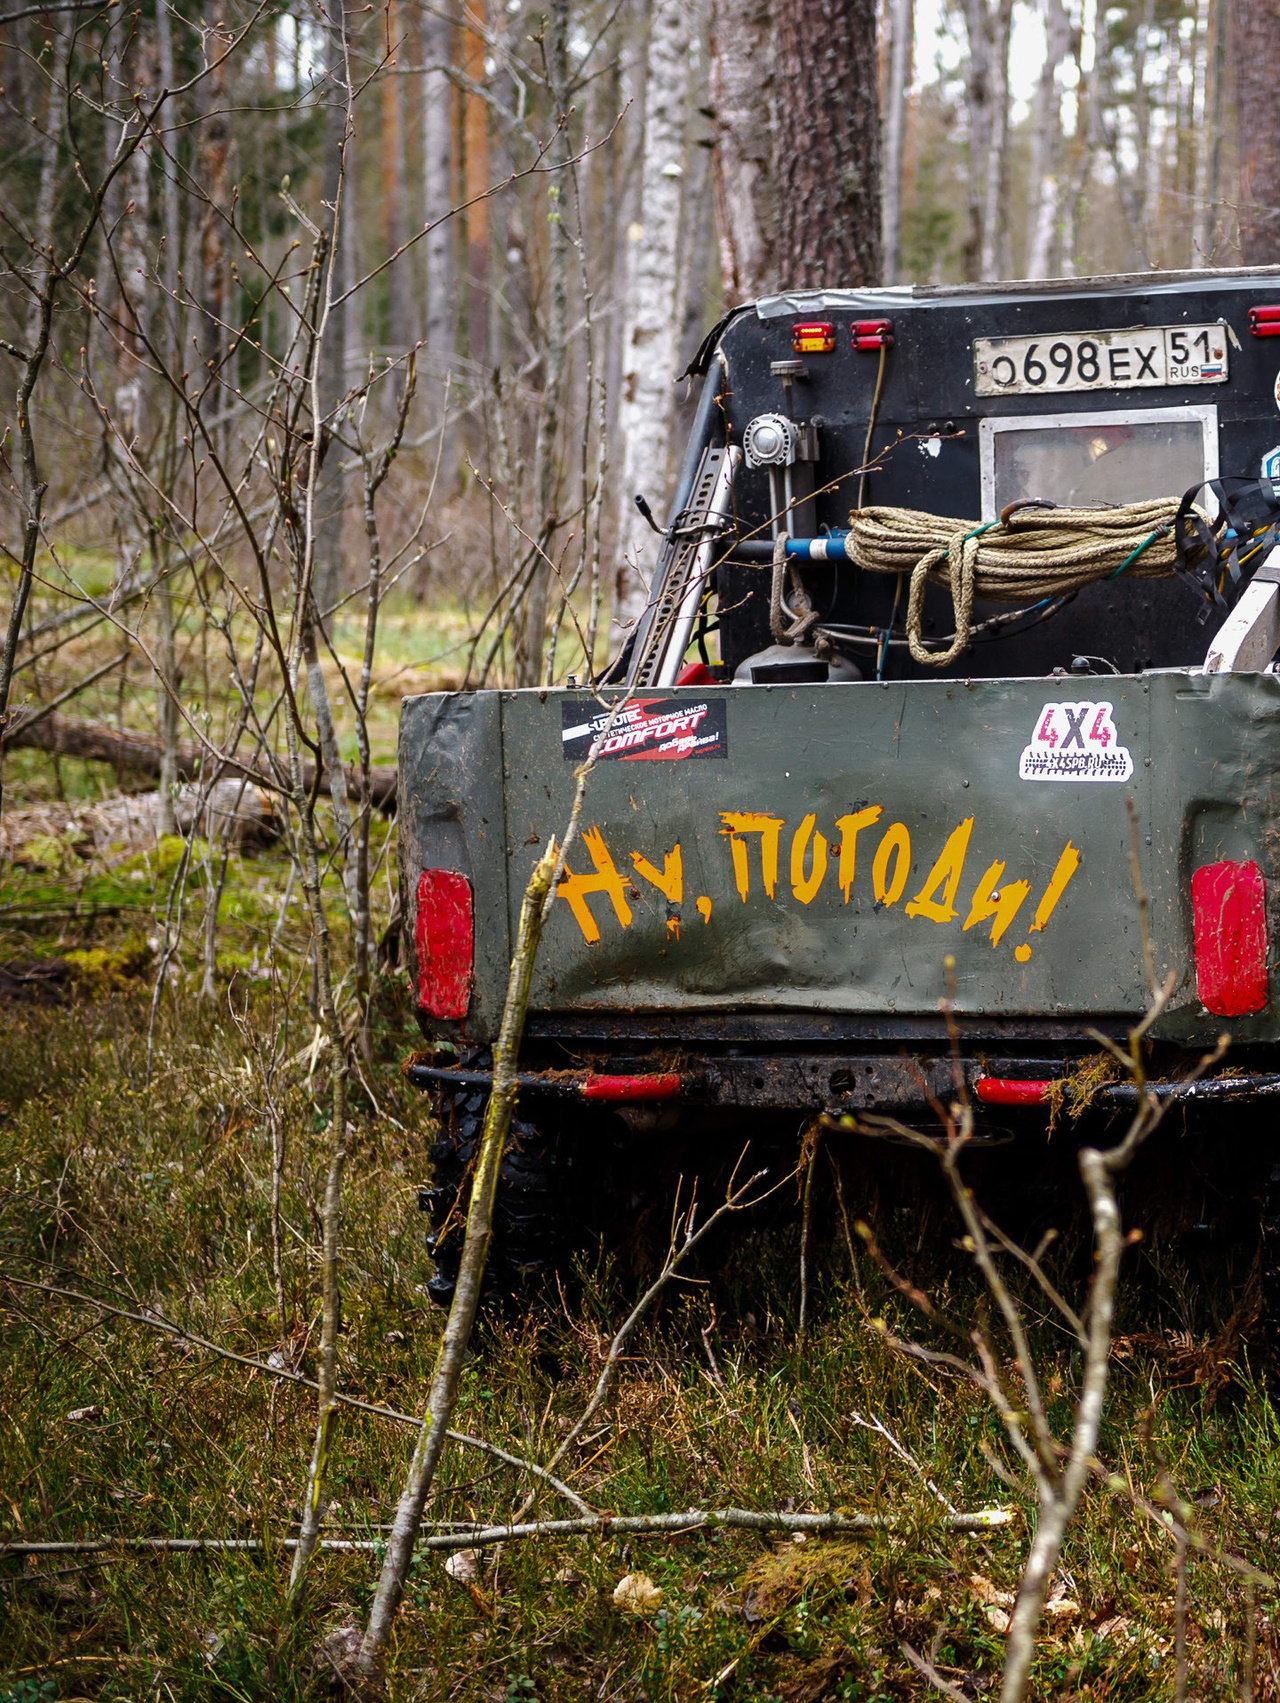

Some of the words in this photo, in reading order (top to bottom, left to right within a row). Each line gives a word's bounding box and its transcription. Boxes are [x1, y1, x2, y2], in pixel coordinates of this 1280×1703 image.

[1171, 331, 1210, 364] 51
[1170, 366, 1199, 379] RUS
[648, 710, 684, 726] МОТОРНОЕ
[683, 703, 708, 716] МАСЛО
[1038, 708, 1111, 748] 4X4
